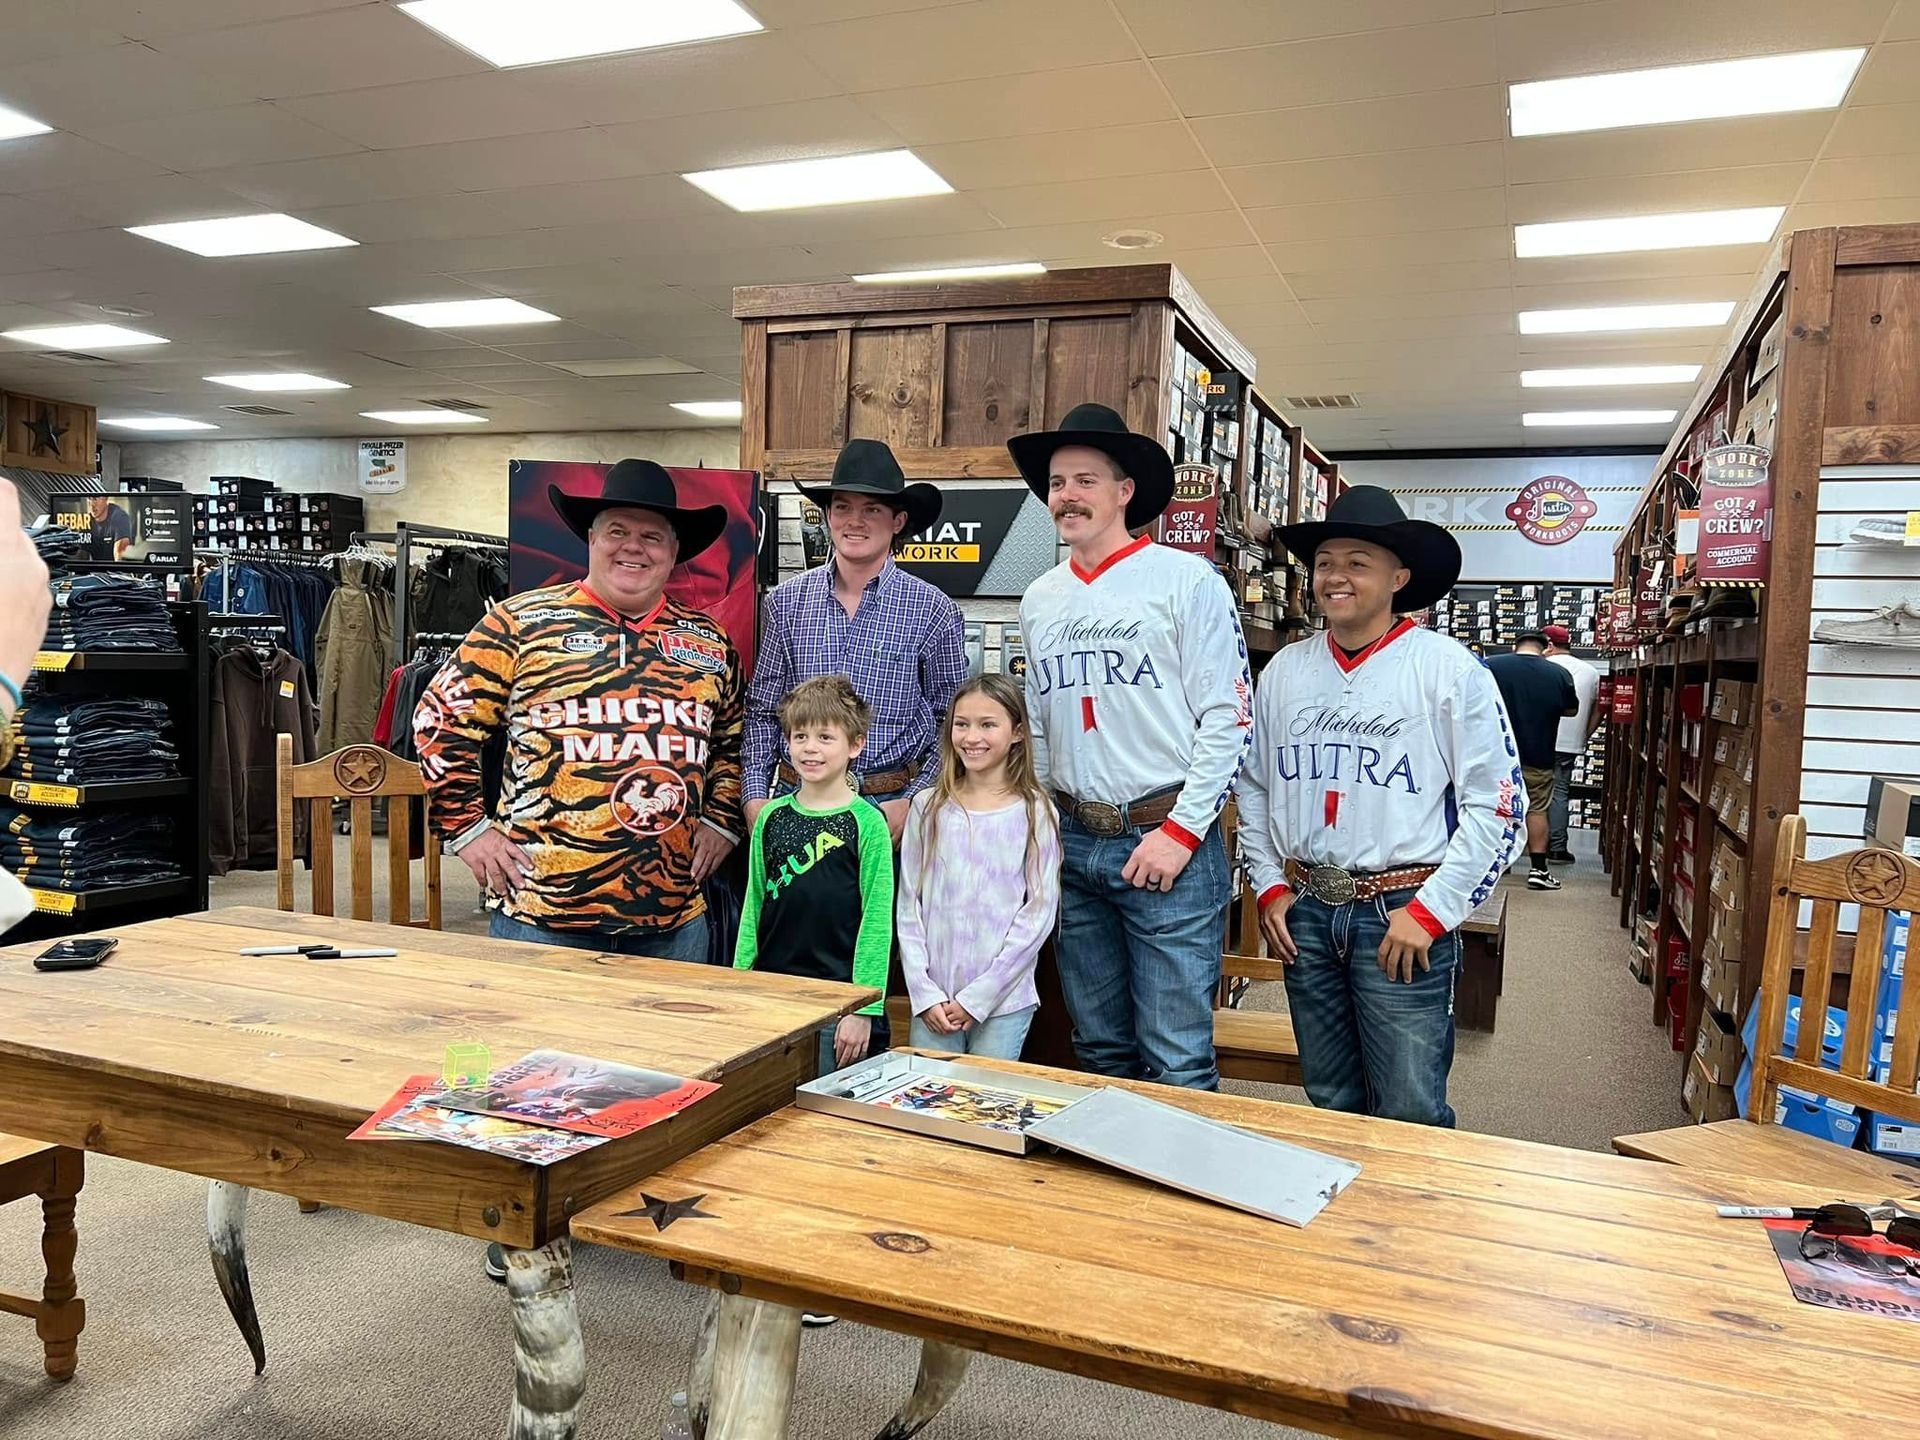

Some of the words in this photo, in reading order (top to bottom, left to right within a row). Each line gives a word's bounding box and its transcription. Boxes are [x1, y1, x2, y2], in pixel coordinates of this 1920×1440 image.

[369, 449, 396, 457] GENETICS
[1715, 452, 1759, 467] WORK
[1174, 470, 1207, 484] WORK
[1719, 468, 1754, 479] ZONE
[1176, 485, 1203, 495] ZONE
[1523, 479, 1579, 500] ORIGINAL
[1396, 497, 1492, 524] RK
[1526, 497, 1570, 522] Justin
[1714, 497, 1744, 511] GOT
[1745, 499, 1757, 512] A
[57, 513, 91, 530] REBAR
[1172, 511, 1196, 523] GOT
[1196, 513, 1206, 523] A
[913, 522, 982, 542] IAT
[1523, 521, 1579, 540] WORKBOOTS
[1705, 518, 1764, 534] CREW?
[1165, 530, 1211, 544] CREW?
[1706, 546, 1759, 559] COMMERCIAL
[1715, 554, 1753, 565] ACCOUNT
[1640, 591, 1663, 601] CRE
[677, 619, 719, 642] CINCH
[1039, 615, 1142, 652] Michelob
[528, 696, 714, 736] CHICKE
[1289, 705, 1408, 739] Michelob
[1277, 743, 1419, 795] ULTRA
